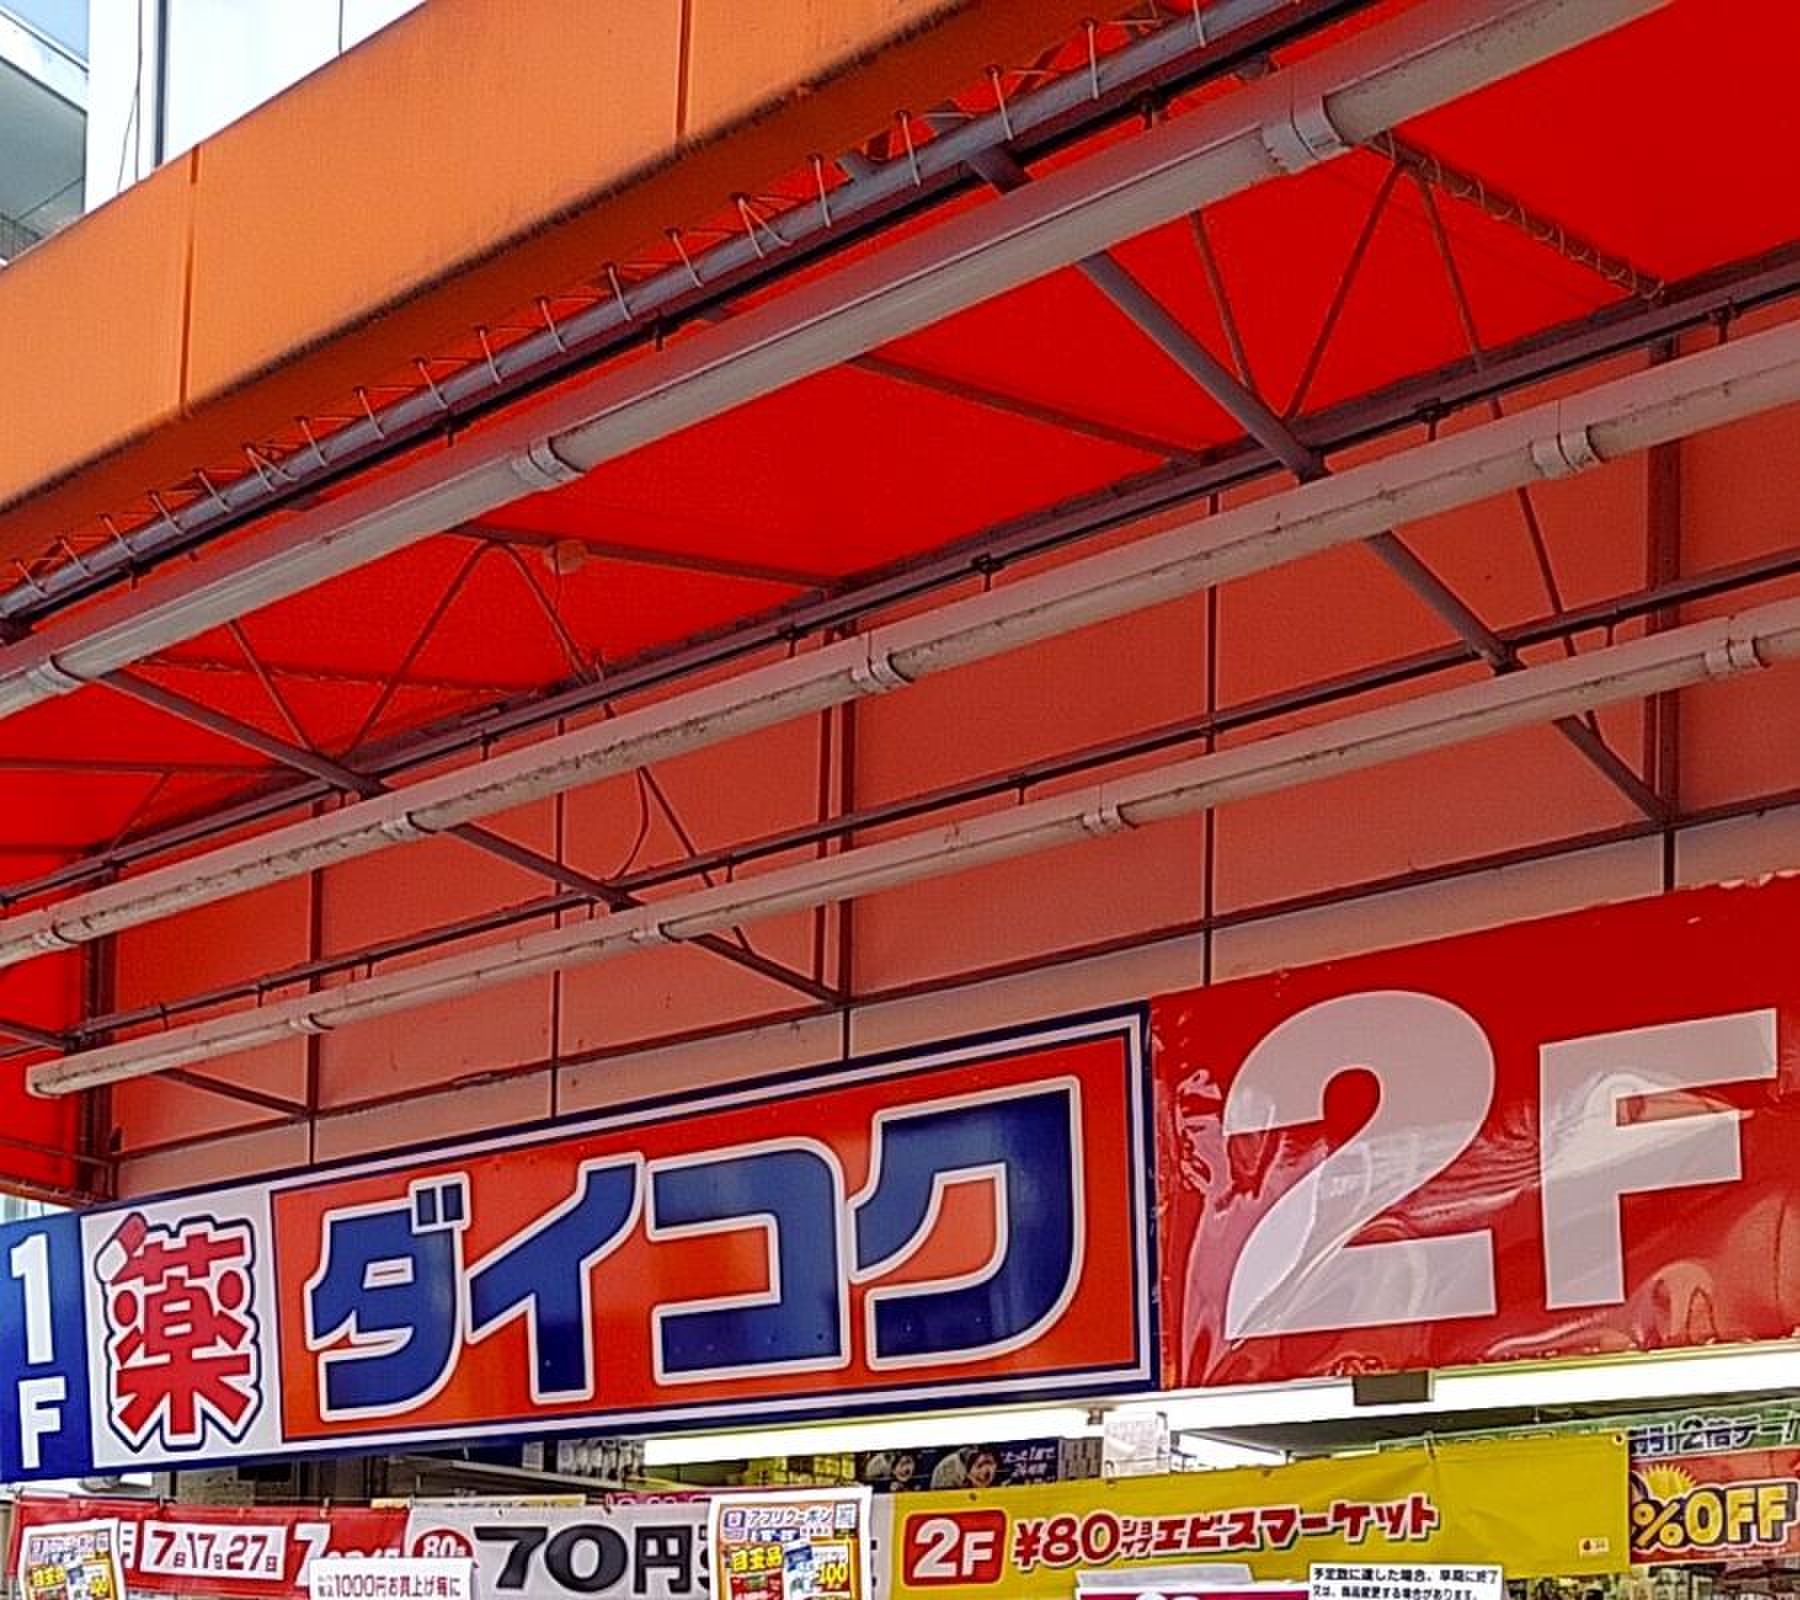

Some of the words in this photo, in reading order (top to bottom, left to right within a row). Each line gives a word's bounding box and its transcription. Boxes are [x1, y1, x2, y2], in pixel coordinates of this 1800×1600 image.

[95, 1212, 262, 1453] 薬
[306, 1074, 1084, 1421] ダイコク
[1222, 989, 1777, 1340] 2F
[912, 1517, 994, 1578] 2F
